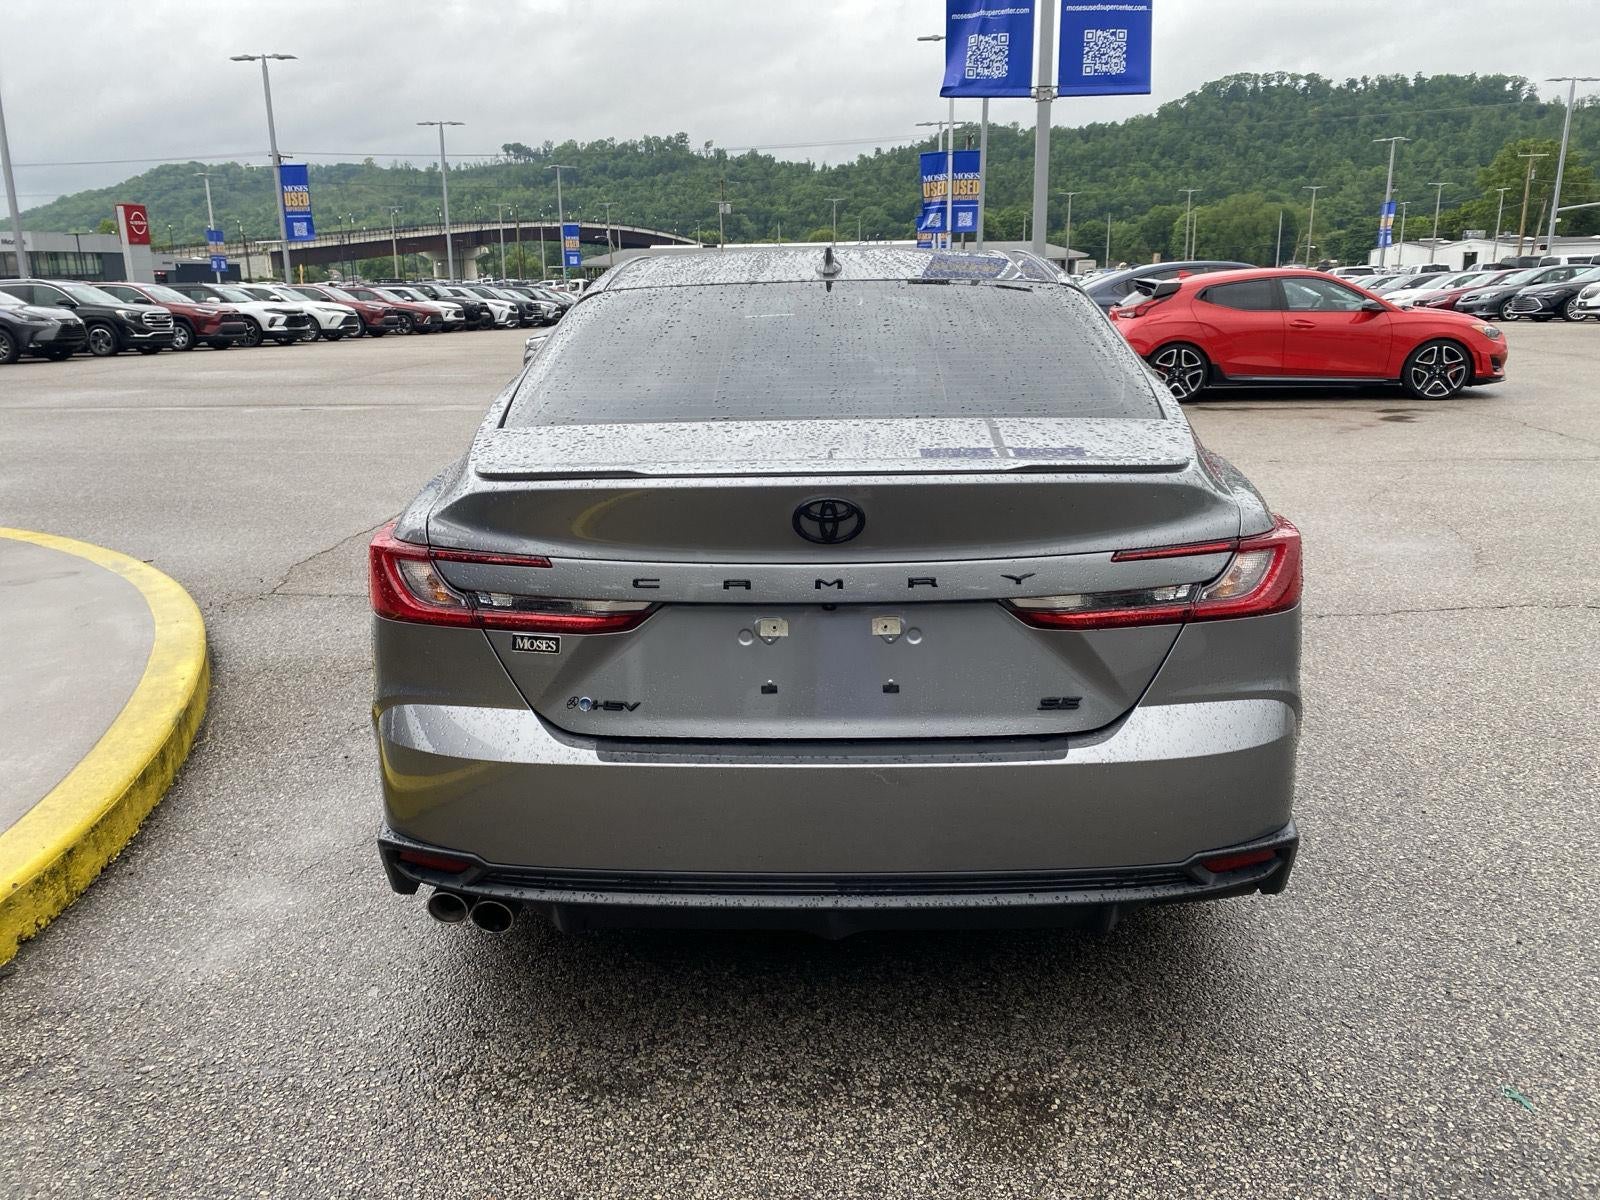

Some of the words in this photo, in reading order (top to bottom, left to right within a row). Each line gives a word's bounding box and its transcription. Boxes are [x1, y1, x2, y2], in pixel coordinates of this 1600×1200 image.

[952, 8, 1029, 19] mosesusedsupercenter.com
[923, 173, 948, 182] MOSES
[923, 181, 948, 197] USED
[953, 180, 980, 195] USED
[284, 192, 310, 206] USED
[515, 636, 556, 651] MOSES
[1037, 697, 1083, 710] SE
